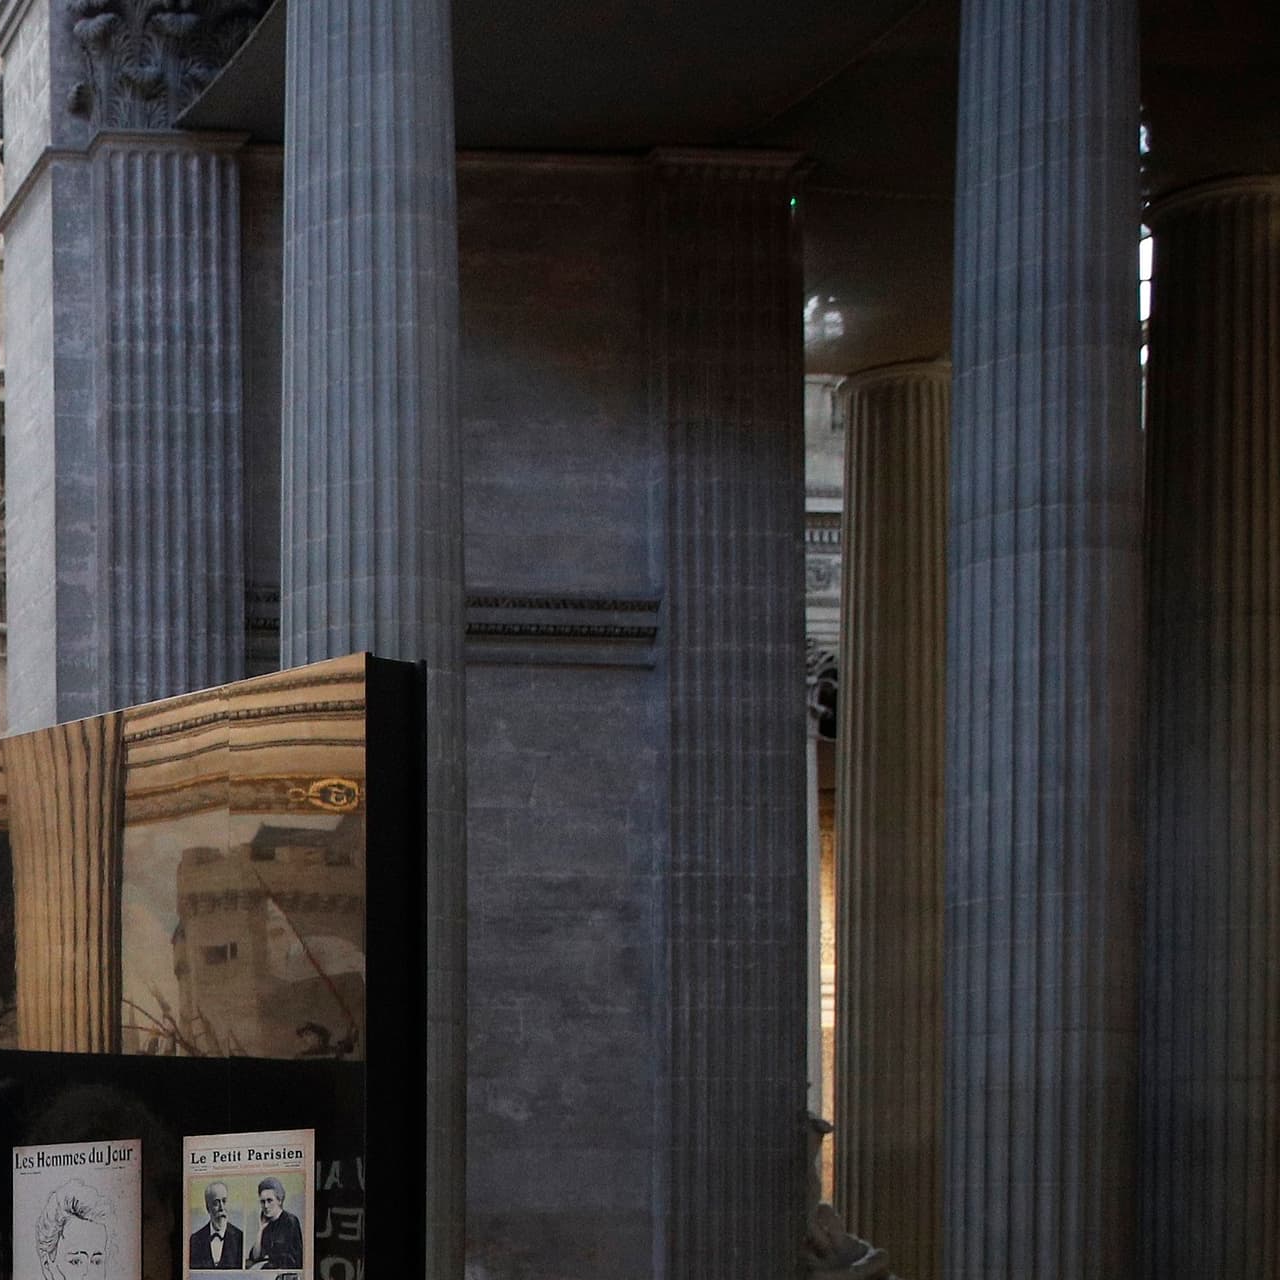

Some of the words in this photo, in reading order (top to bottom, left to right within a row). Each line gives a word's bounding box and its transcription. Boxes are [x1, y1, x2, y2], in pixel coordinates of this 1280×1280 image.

[15, 1153, 34, 1169] Les
[37, 1151, 85, 1167] Hommes
[88, 1147, 103, 1163] du
[105, 1145, 133, 1165] Jour
[191, 1152, 206, 1164] Le
[213, 1150, 240, 1162] Petit
[248, 1148, 302, 1160] Parisien
